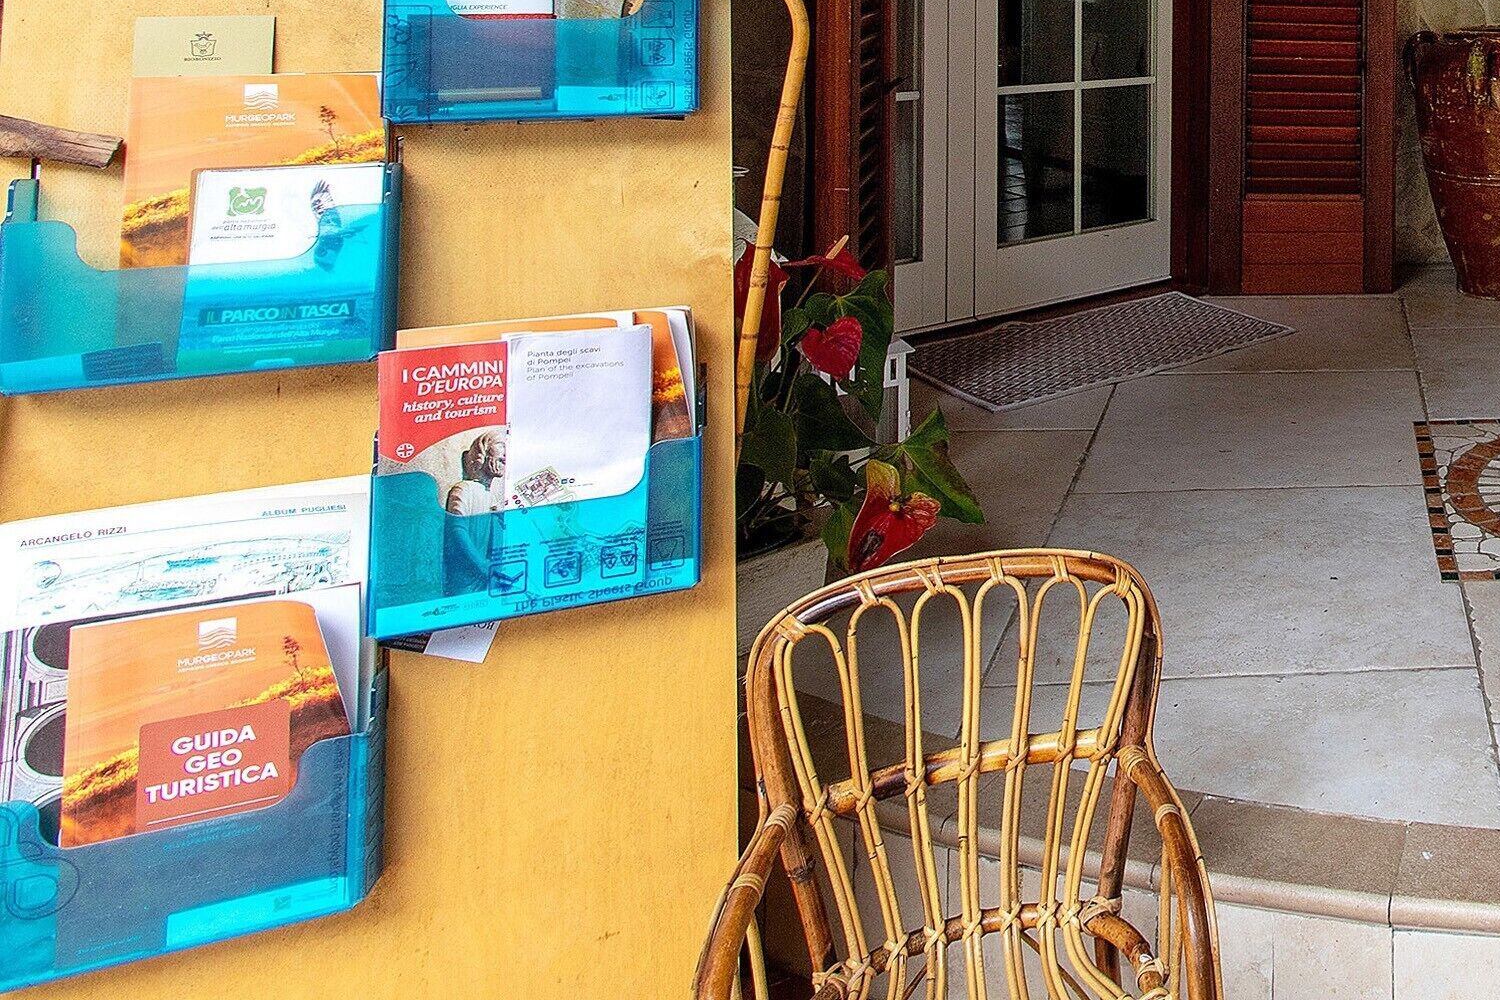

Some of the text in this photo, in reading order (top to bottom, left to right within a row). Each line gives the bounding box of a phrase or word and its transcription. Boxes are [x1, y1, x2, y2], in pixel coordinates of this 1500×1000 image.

[225, 113, 296, 122] MURGEOPARK
[206, 303, 349, 323] IL PARCO IN TASCA
[527, 350, 554, 358] Pianta
[556, 348, 577, 358] degli
[537, 357, 571, 366] Pompei
[402, 360, 503, 383] I CAMMINI
[527, 366, 545, 374] Plan
[576, 360, 624, 371] excavations
[538, 372, 573, 381] Pompeii
[417, 374, 502, 396] D'EUROPA
[403, 392, 504, 414] history, culture
[415, 404, 497, 424] and tourism
[261, 503, 346, 518] ALBUM PUGLIESI
[20, 526, 127, 548] ARCANGELO RIZZI
[177, 647, 256, 667] MURGEOPARK
[171, 724, 256, 755] GUIDA
[184, 748, 243, 773] GEO
[144, 762, 279, 804] TURISTICA
